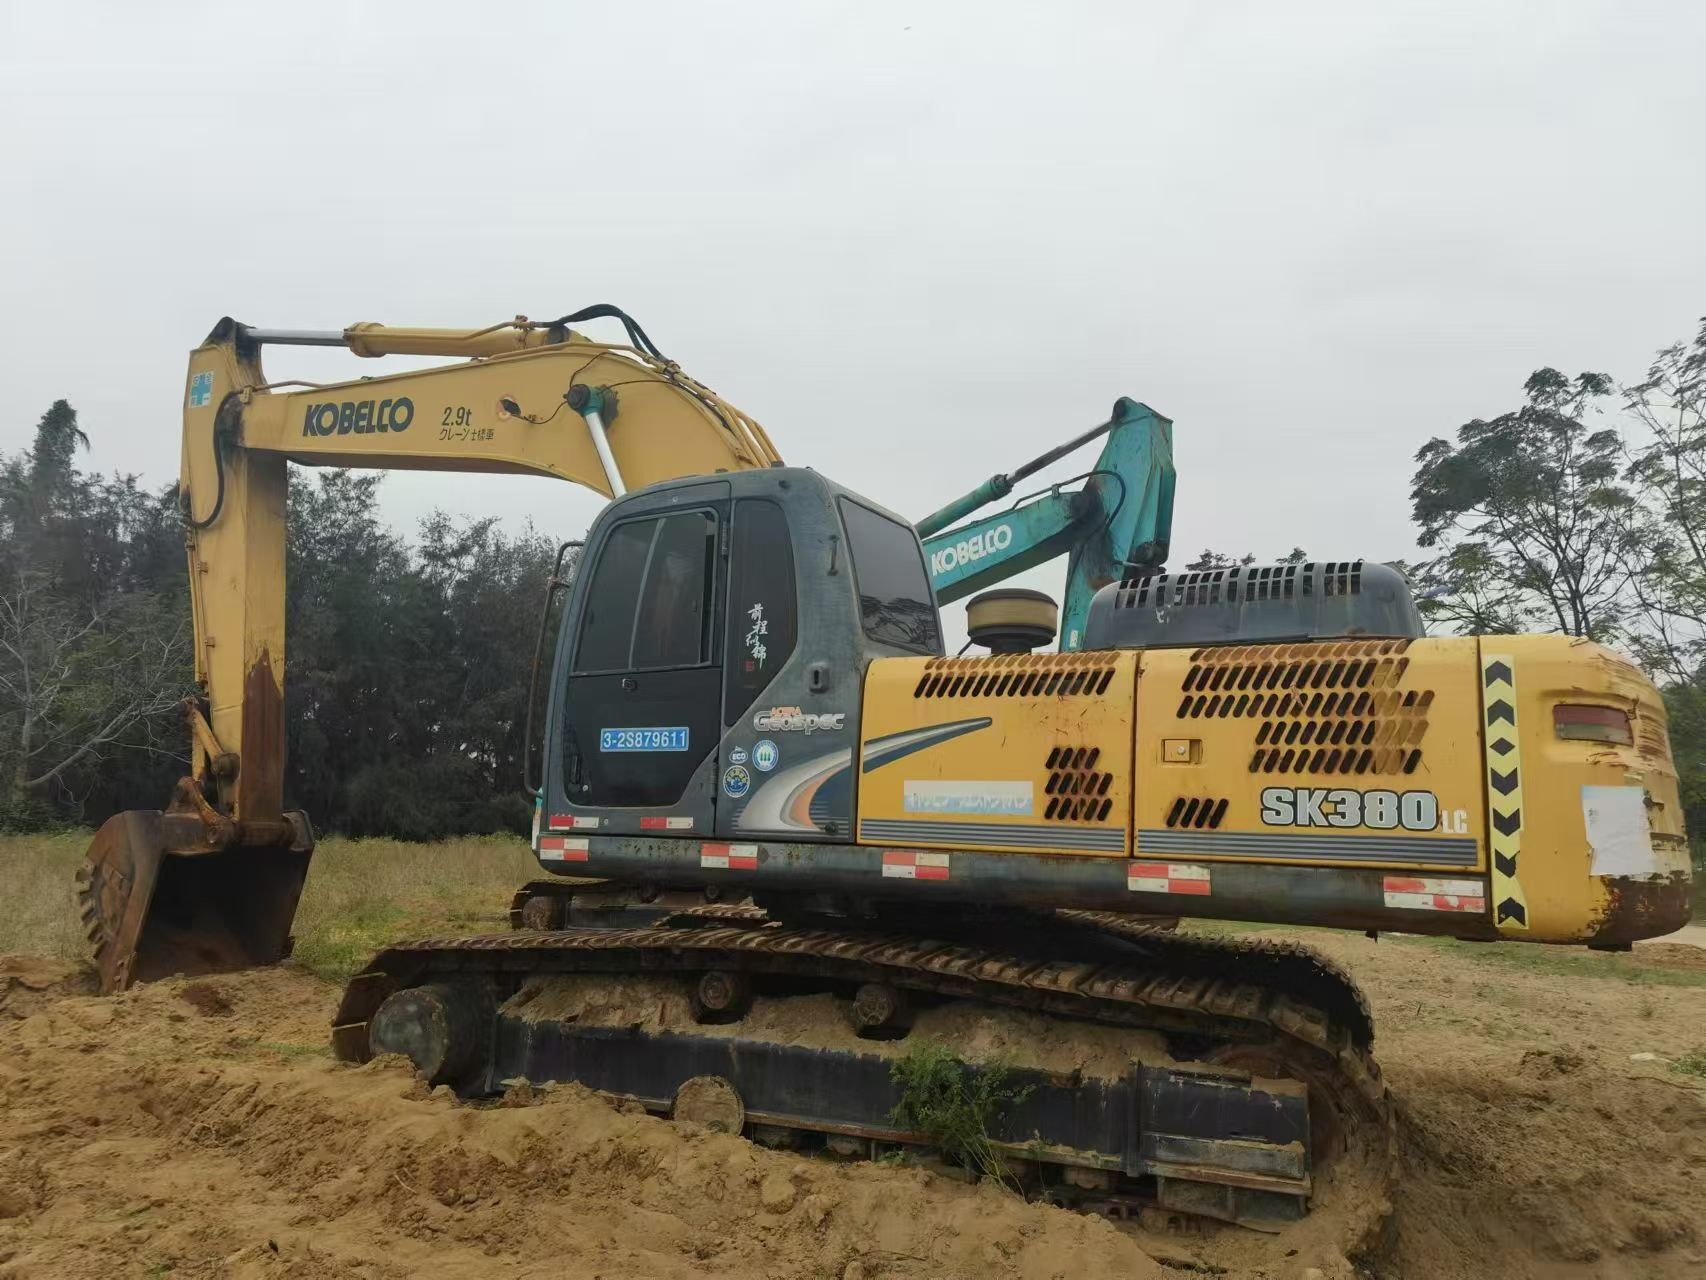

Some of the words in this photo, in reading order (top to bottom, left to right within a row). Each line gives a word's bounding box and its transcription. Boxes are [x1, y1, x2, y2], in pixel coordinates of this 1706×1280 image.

[303, 397, 415, 437] KOBELCO
[442, 406, 472, 426] 2.9t
[931, 524, 1012, 577] KOBELCO
[603, 731, 686, 748] 3-2S879611
[732, 752, 746, 761] ECO
[1260, 786, 1439, 832] SK380
